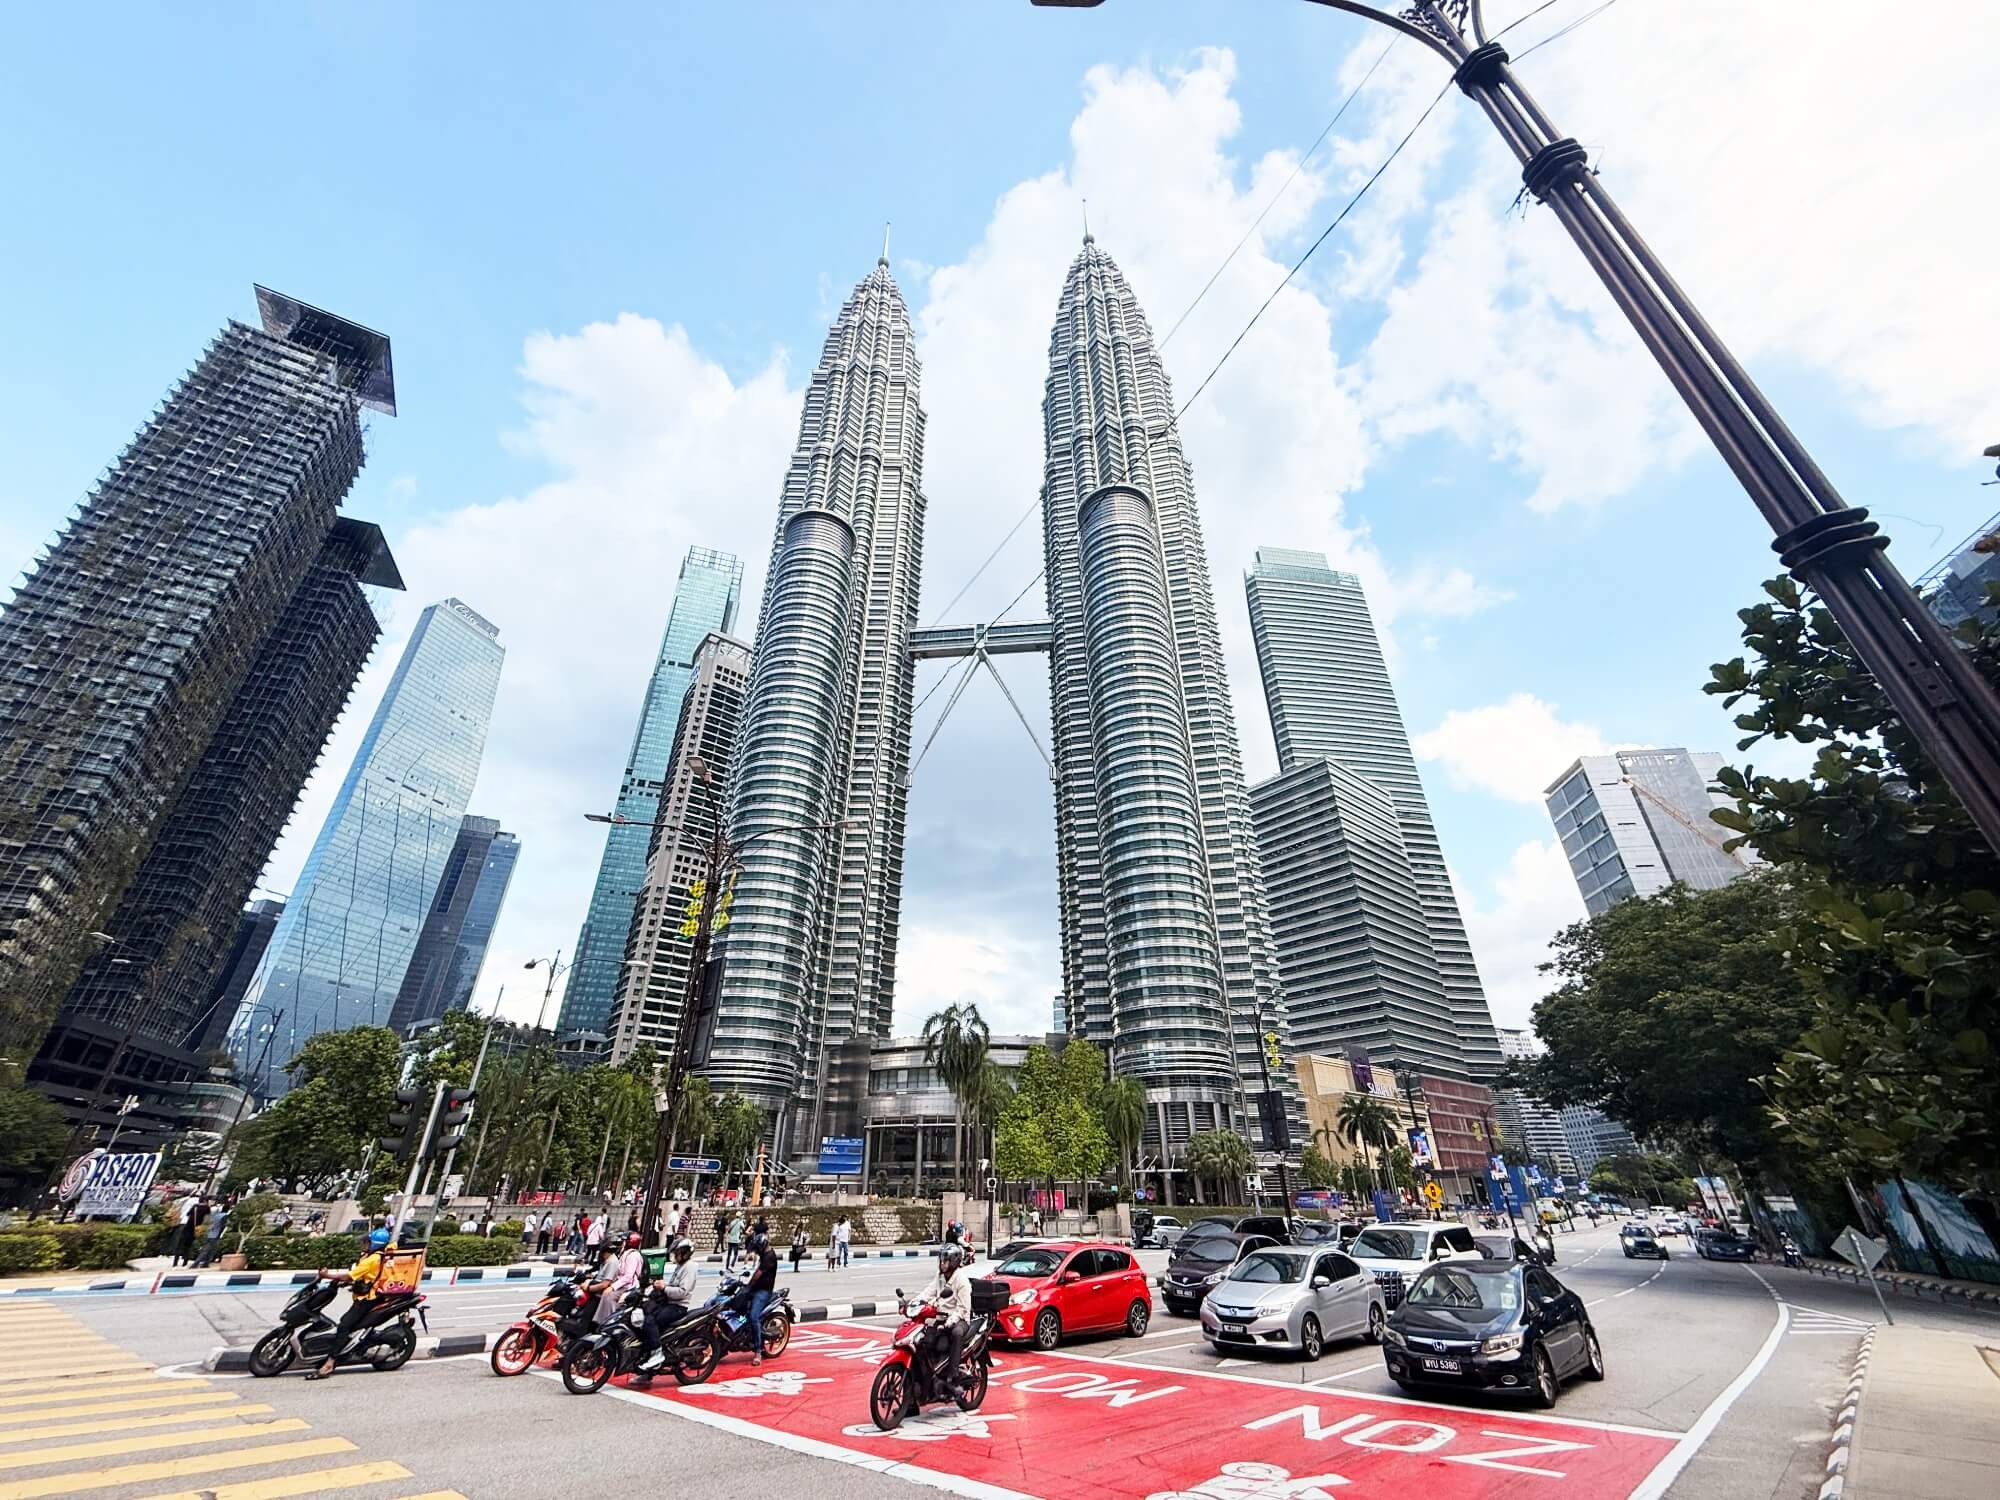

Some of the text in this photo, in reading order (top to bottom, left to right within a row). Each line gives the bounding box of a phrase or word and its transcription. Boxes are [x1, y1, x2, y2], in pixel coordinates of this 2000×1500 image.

[88, 1154, 157, 1187] ASEAN
[1424, 1359, 1458, 1370] WYU 5380
[1241, 1404, 1598, 1479] ZON
